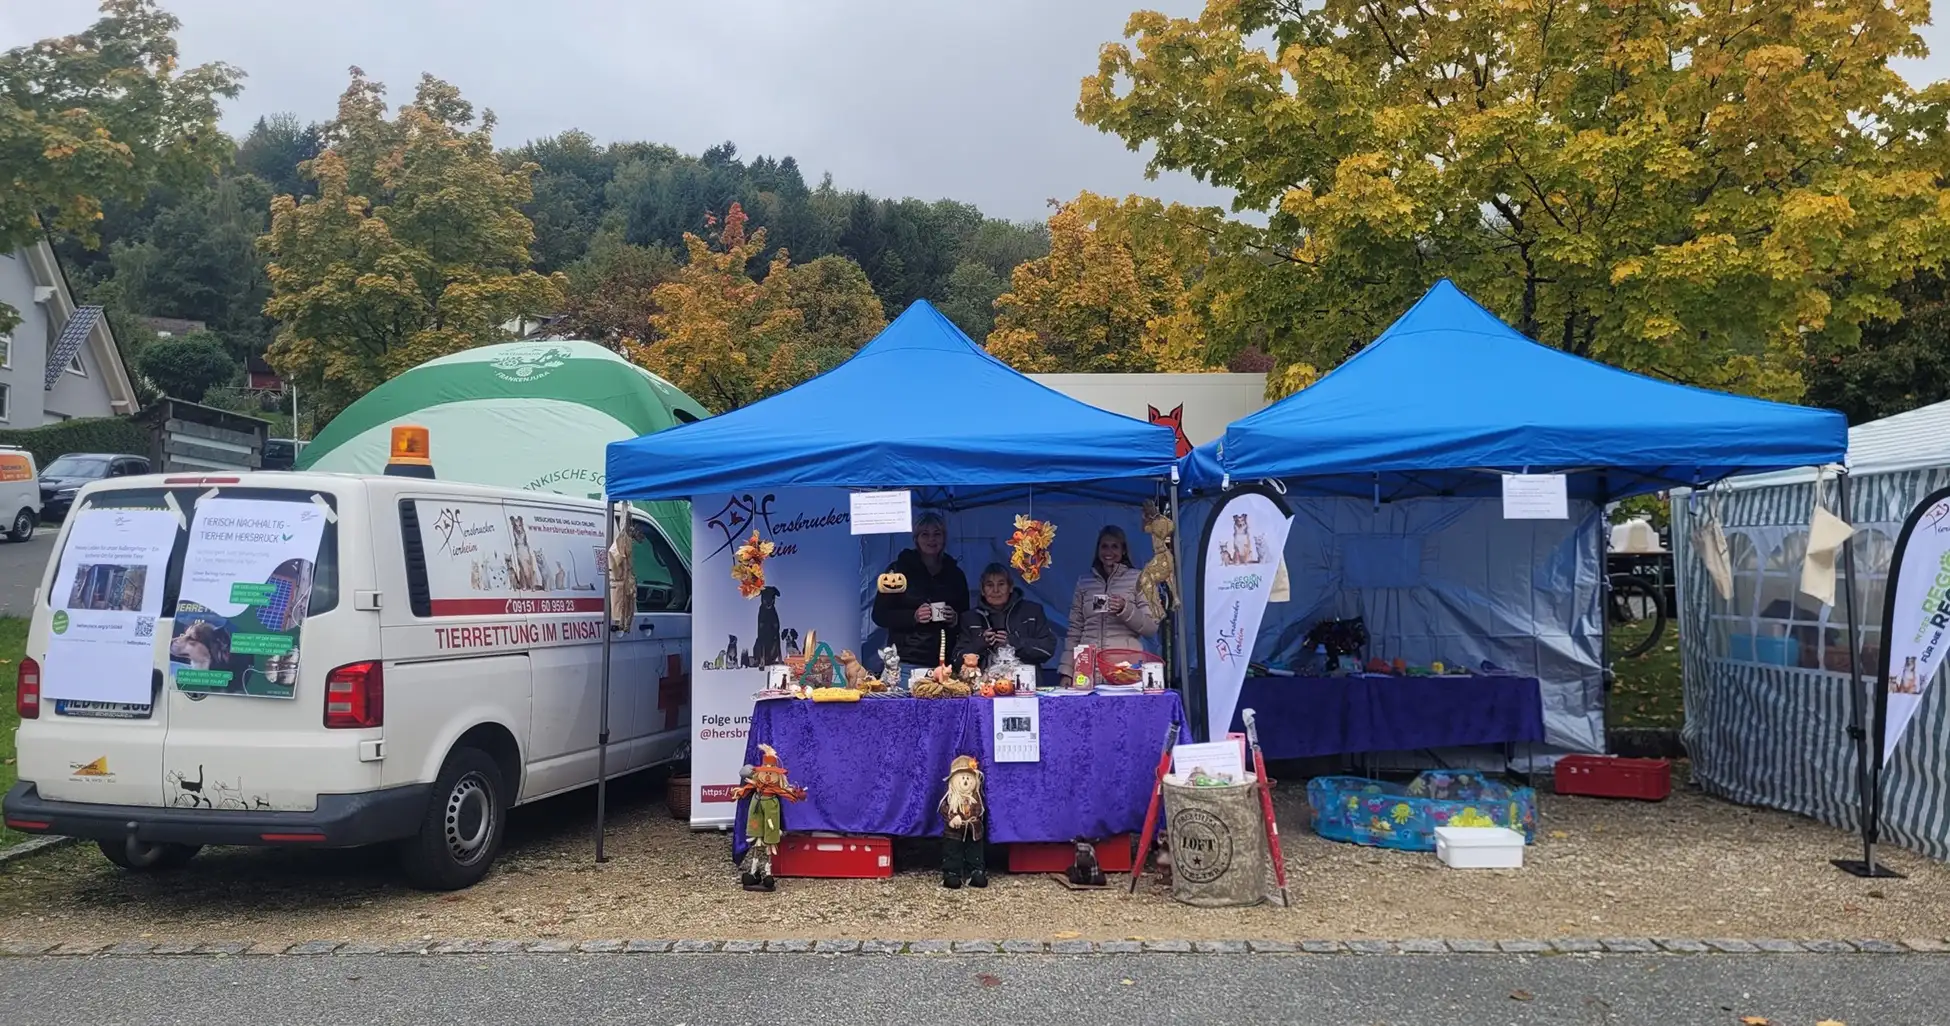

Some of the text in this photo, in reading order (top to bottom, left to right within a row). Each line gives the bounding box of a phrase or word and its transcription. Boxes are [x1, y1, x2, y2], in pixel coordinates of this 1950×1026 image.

[494, 370, 551, 383] FRANKENJURA
[589, 471, 606, 487] SC
[203, 517, 235, 527] TIERISCH
[236, 518, 285, 529] NACHHALTIG
[201, 531, 279, 543] TIERHEIM HERSBRUCK
[1230, 580, 1259, 590] REGION
[513, 600, 536, 612] 09151
[541, 600, 550, 611] 60
[552, 600, 565, 611] 959
[566, 600, 575, 611] 23
[435, 621, 605, 649] TIERRETTUNG IM EINSAT
[1921, 645, 1935, 664] FÜR
[1930, 630, 1942, 646] DIE
[702, 714, 753, 726] Folge uns
[700, 728, 748, 740] @hersbr
[702, 786, 731, 797] https:/
[1182, 836, 1217, 852] LOFT
